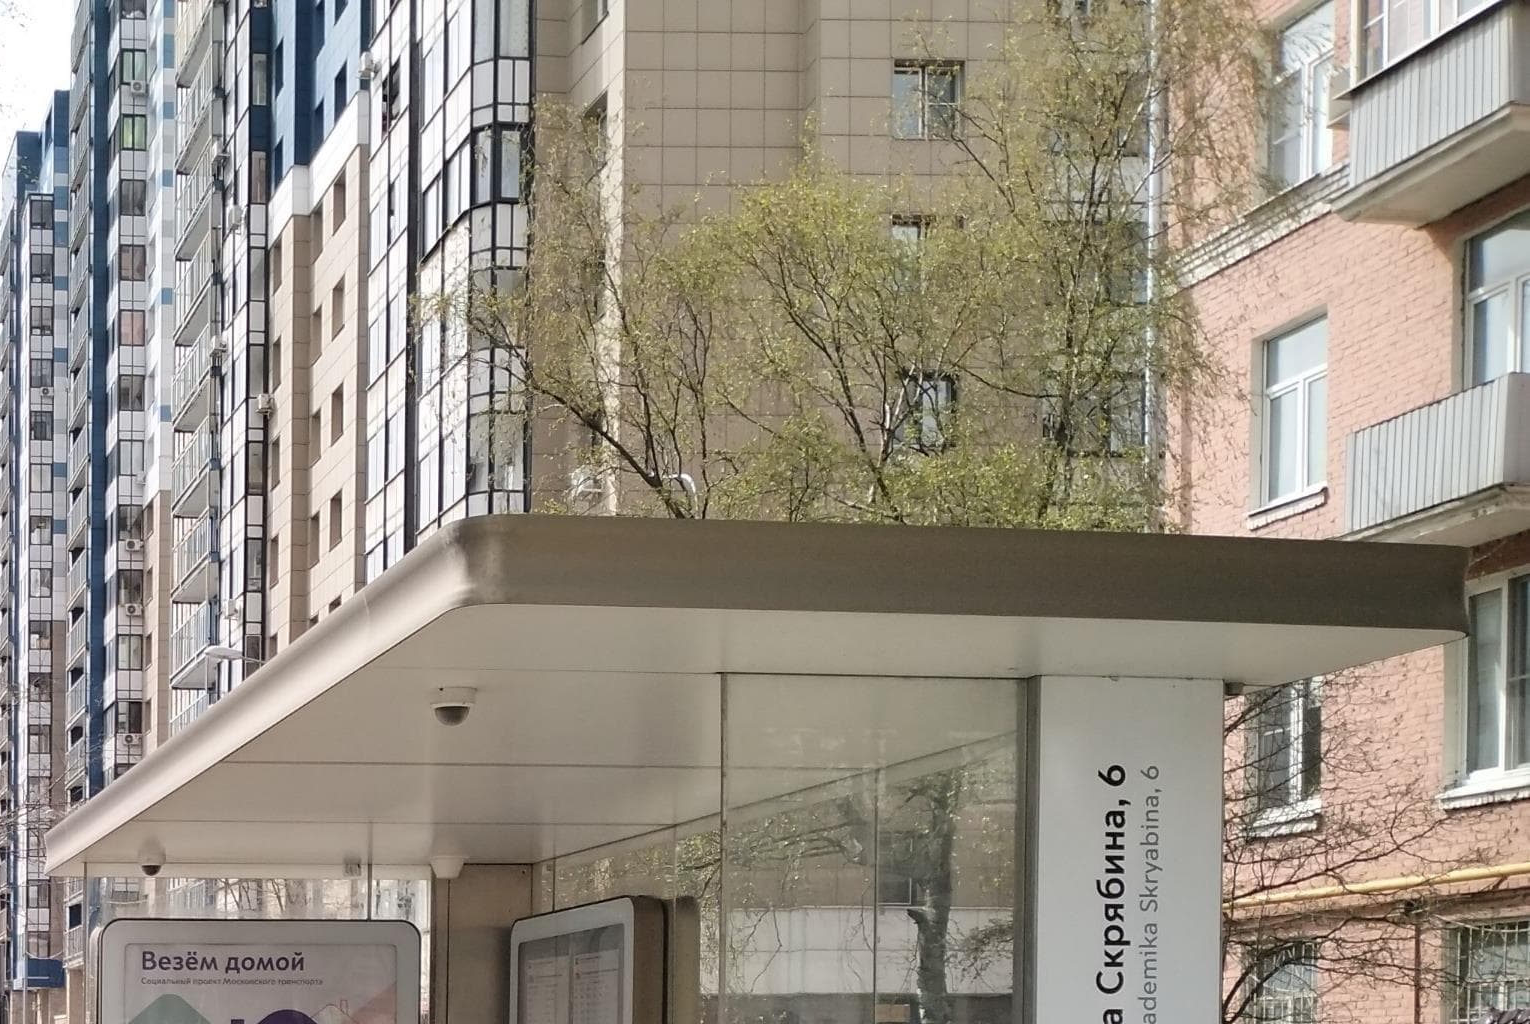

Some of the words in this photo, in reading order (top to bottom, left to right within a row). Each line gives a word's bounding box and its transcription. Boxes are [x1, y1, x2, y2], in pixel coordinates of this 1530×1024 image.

[1098, 764, 1126, 786] 6
[1141, 765, 1159, 780] 6
[1139, 788, 1163, 912] Skryabina,
[1096, 798, 1131, 994] Скрябина,
[142, 951, 218, 971] Везём
[225, 952, 305, 974] домой
